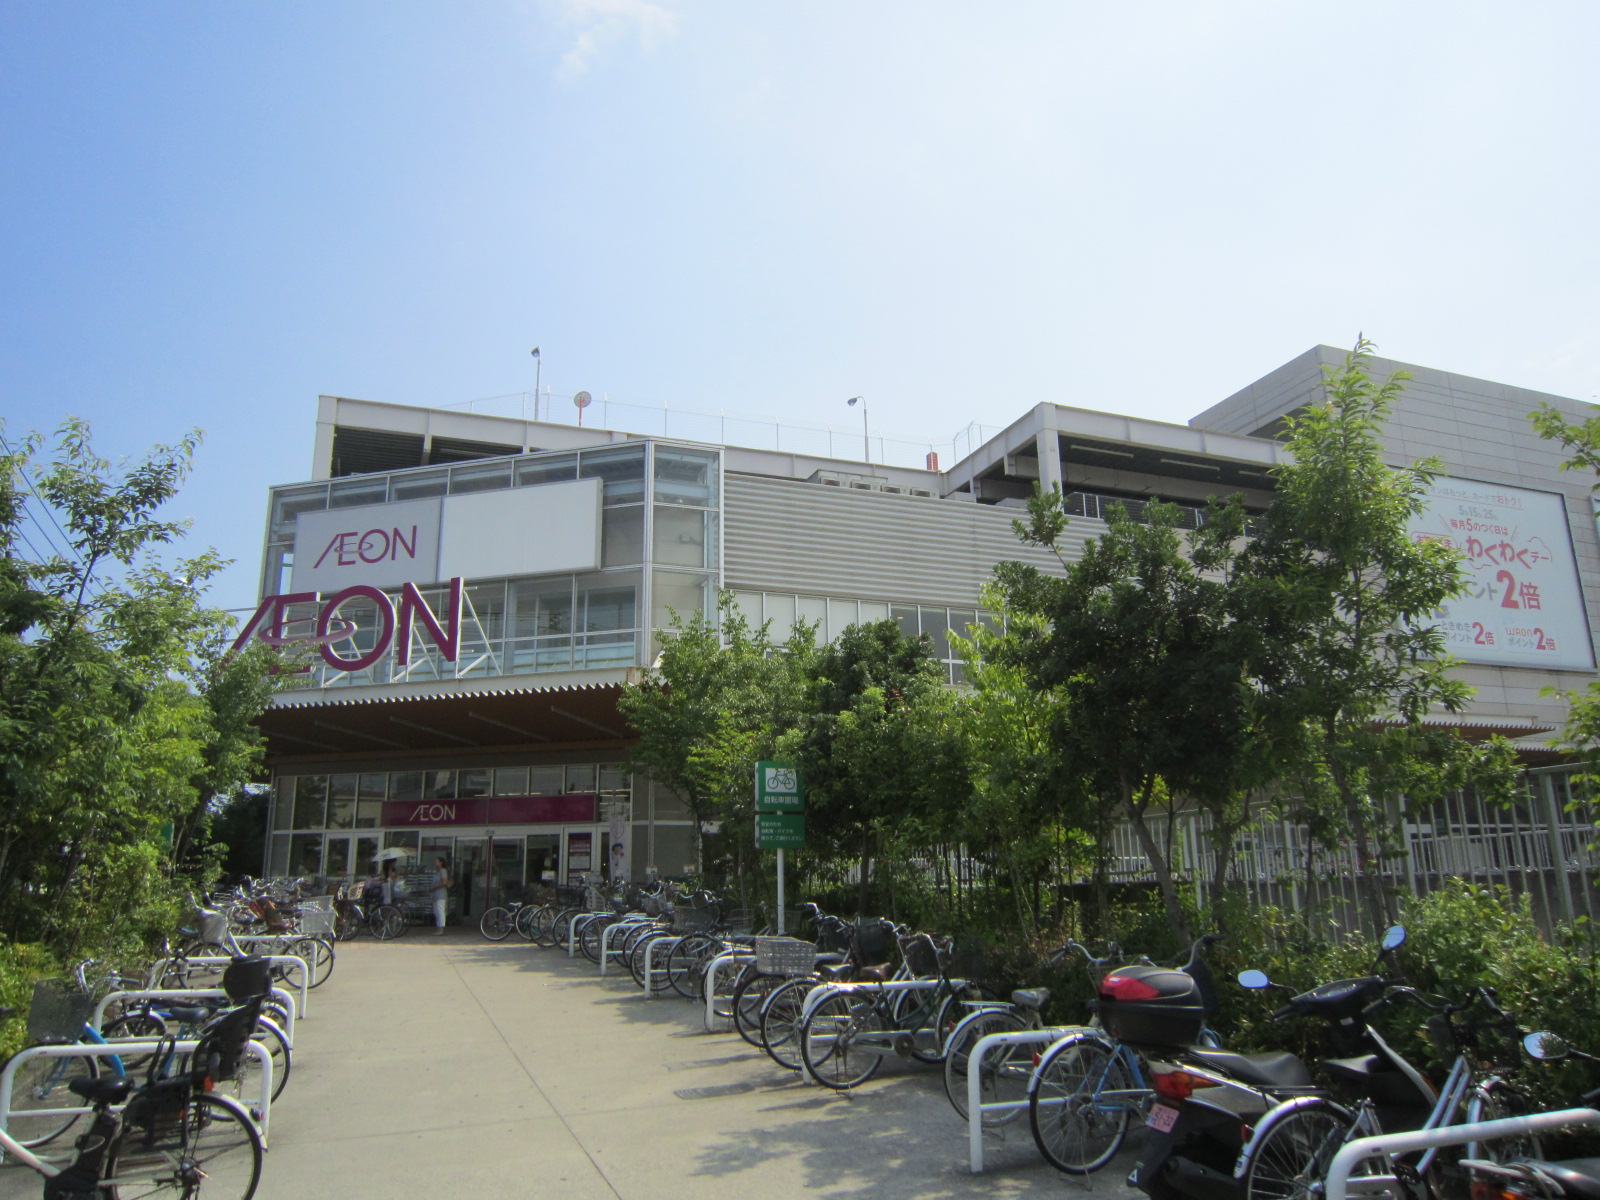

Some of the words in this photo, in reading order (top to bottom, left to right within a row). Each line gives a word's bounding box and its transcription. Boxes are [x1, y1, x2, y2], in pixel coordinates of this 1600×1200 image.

[1450, 518, 1509, 536] 毎月5のつく日は
